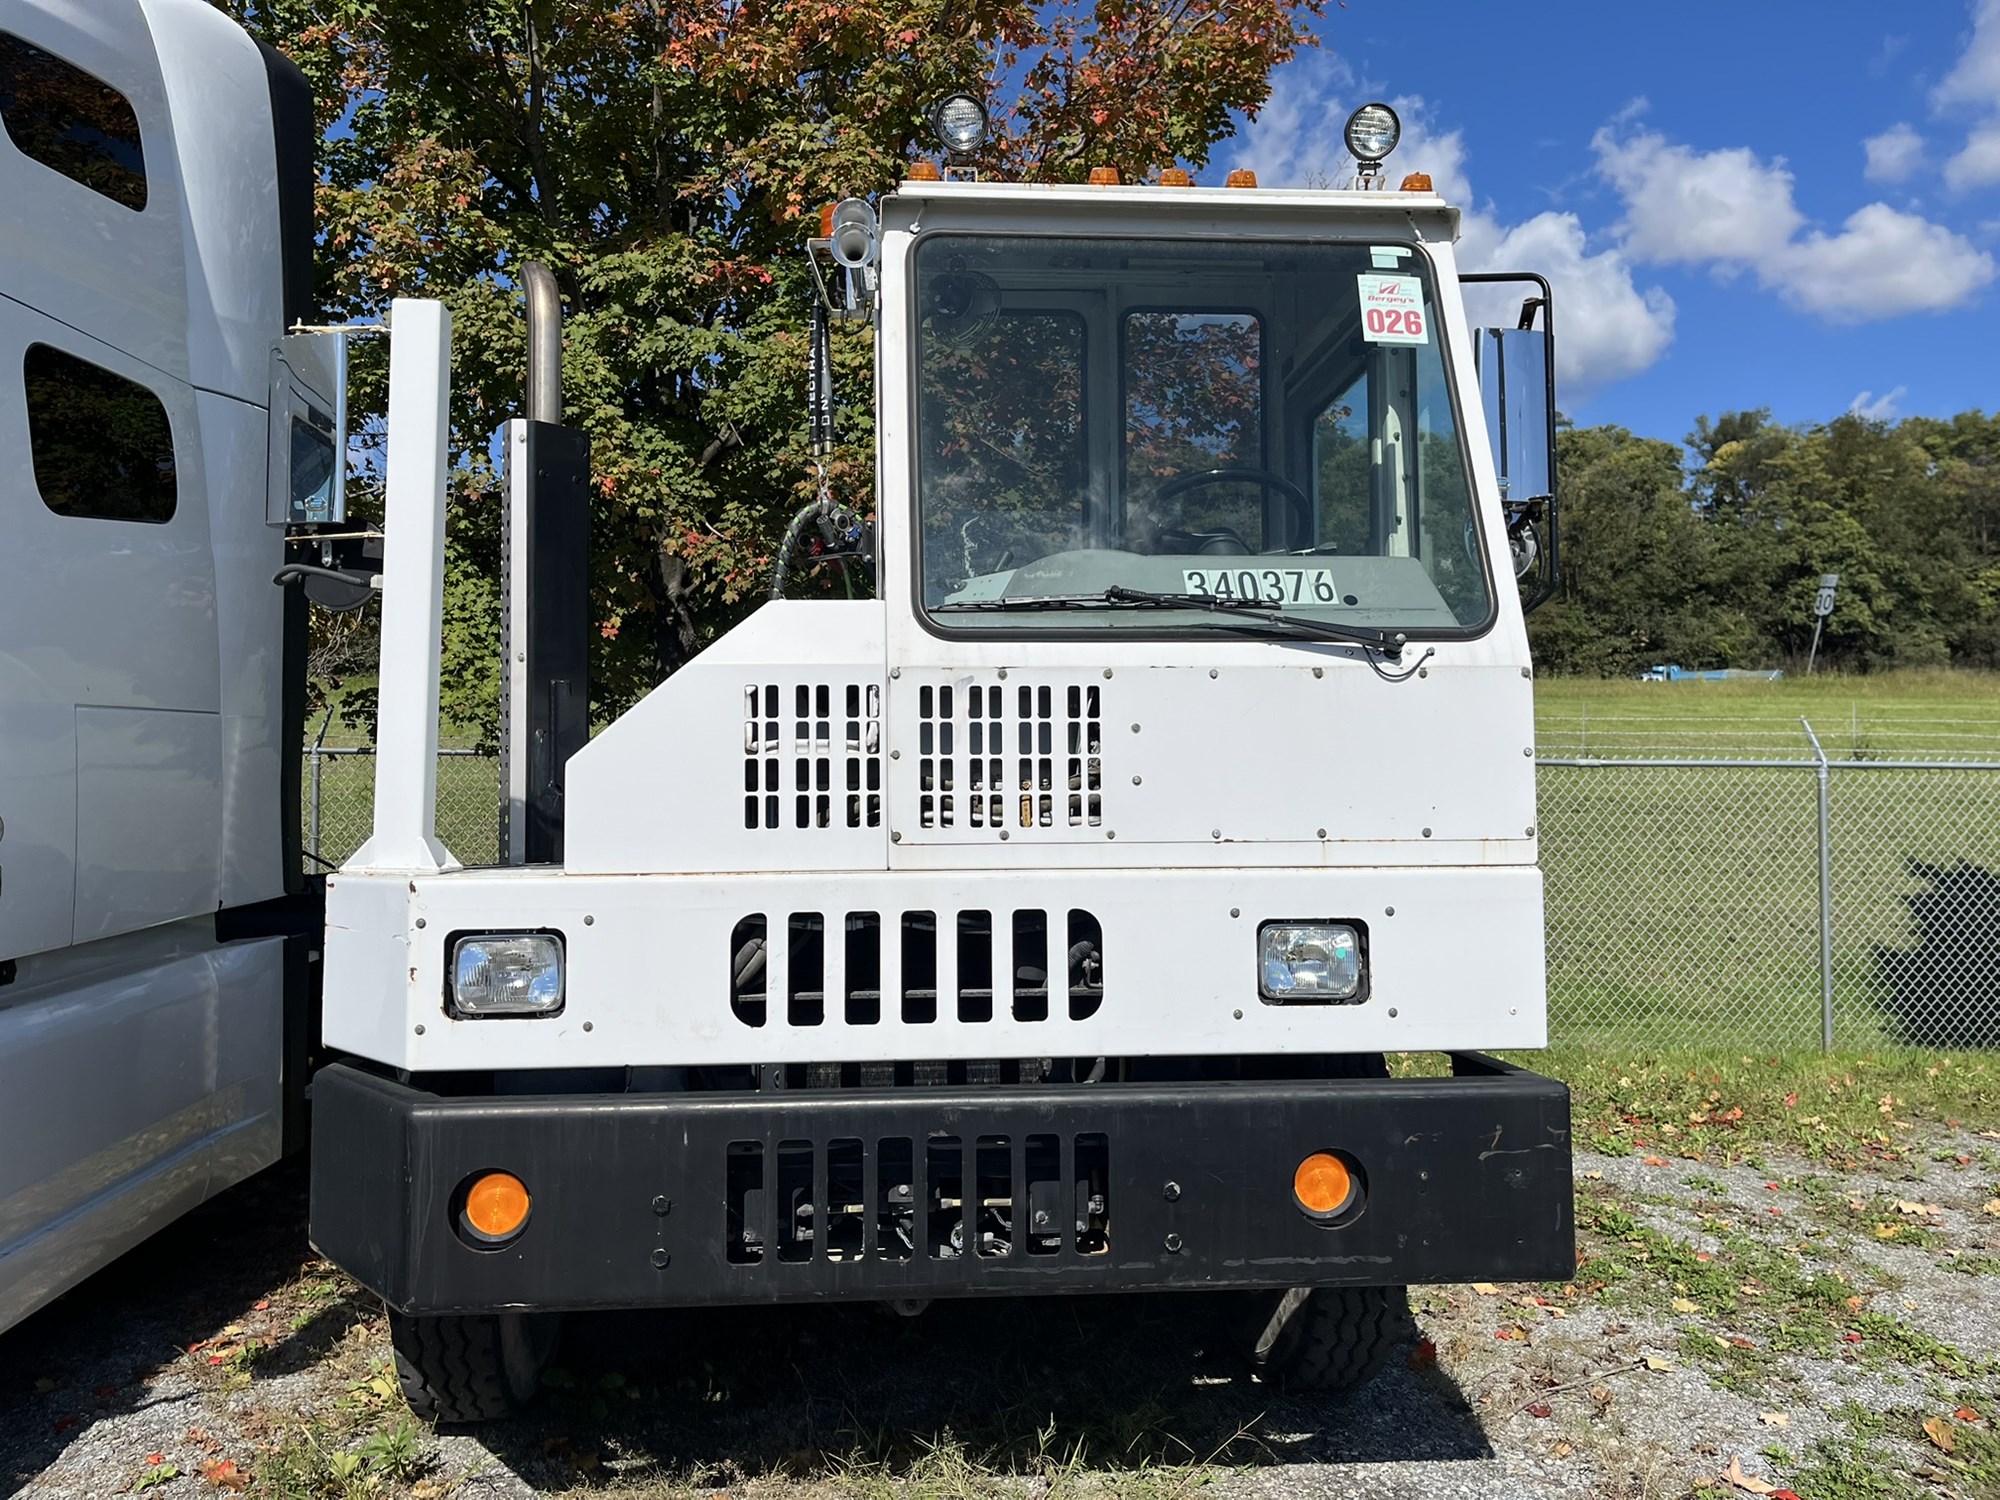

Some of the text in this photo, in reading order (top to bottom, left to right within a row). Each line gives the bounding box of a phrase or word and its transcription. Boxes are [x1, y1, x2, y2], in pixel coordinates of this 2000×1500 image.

[1367, 295, 1415, 304] Bergey's
[1367, 309, 1422, 335] 026
[808, 341, 816, 411] TECTRA
[1187, 571, 1334, 602] 340376
